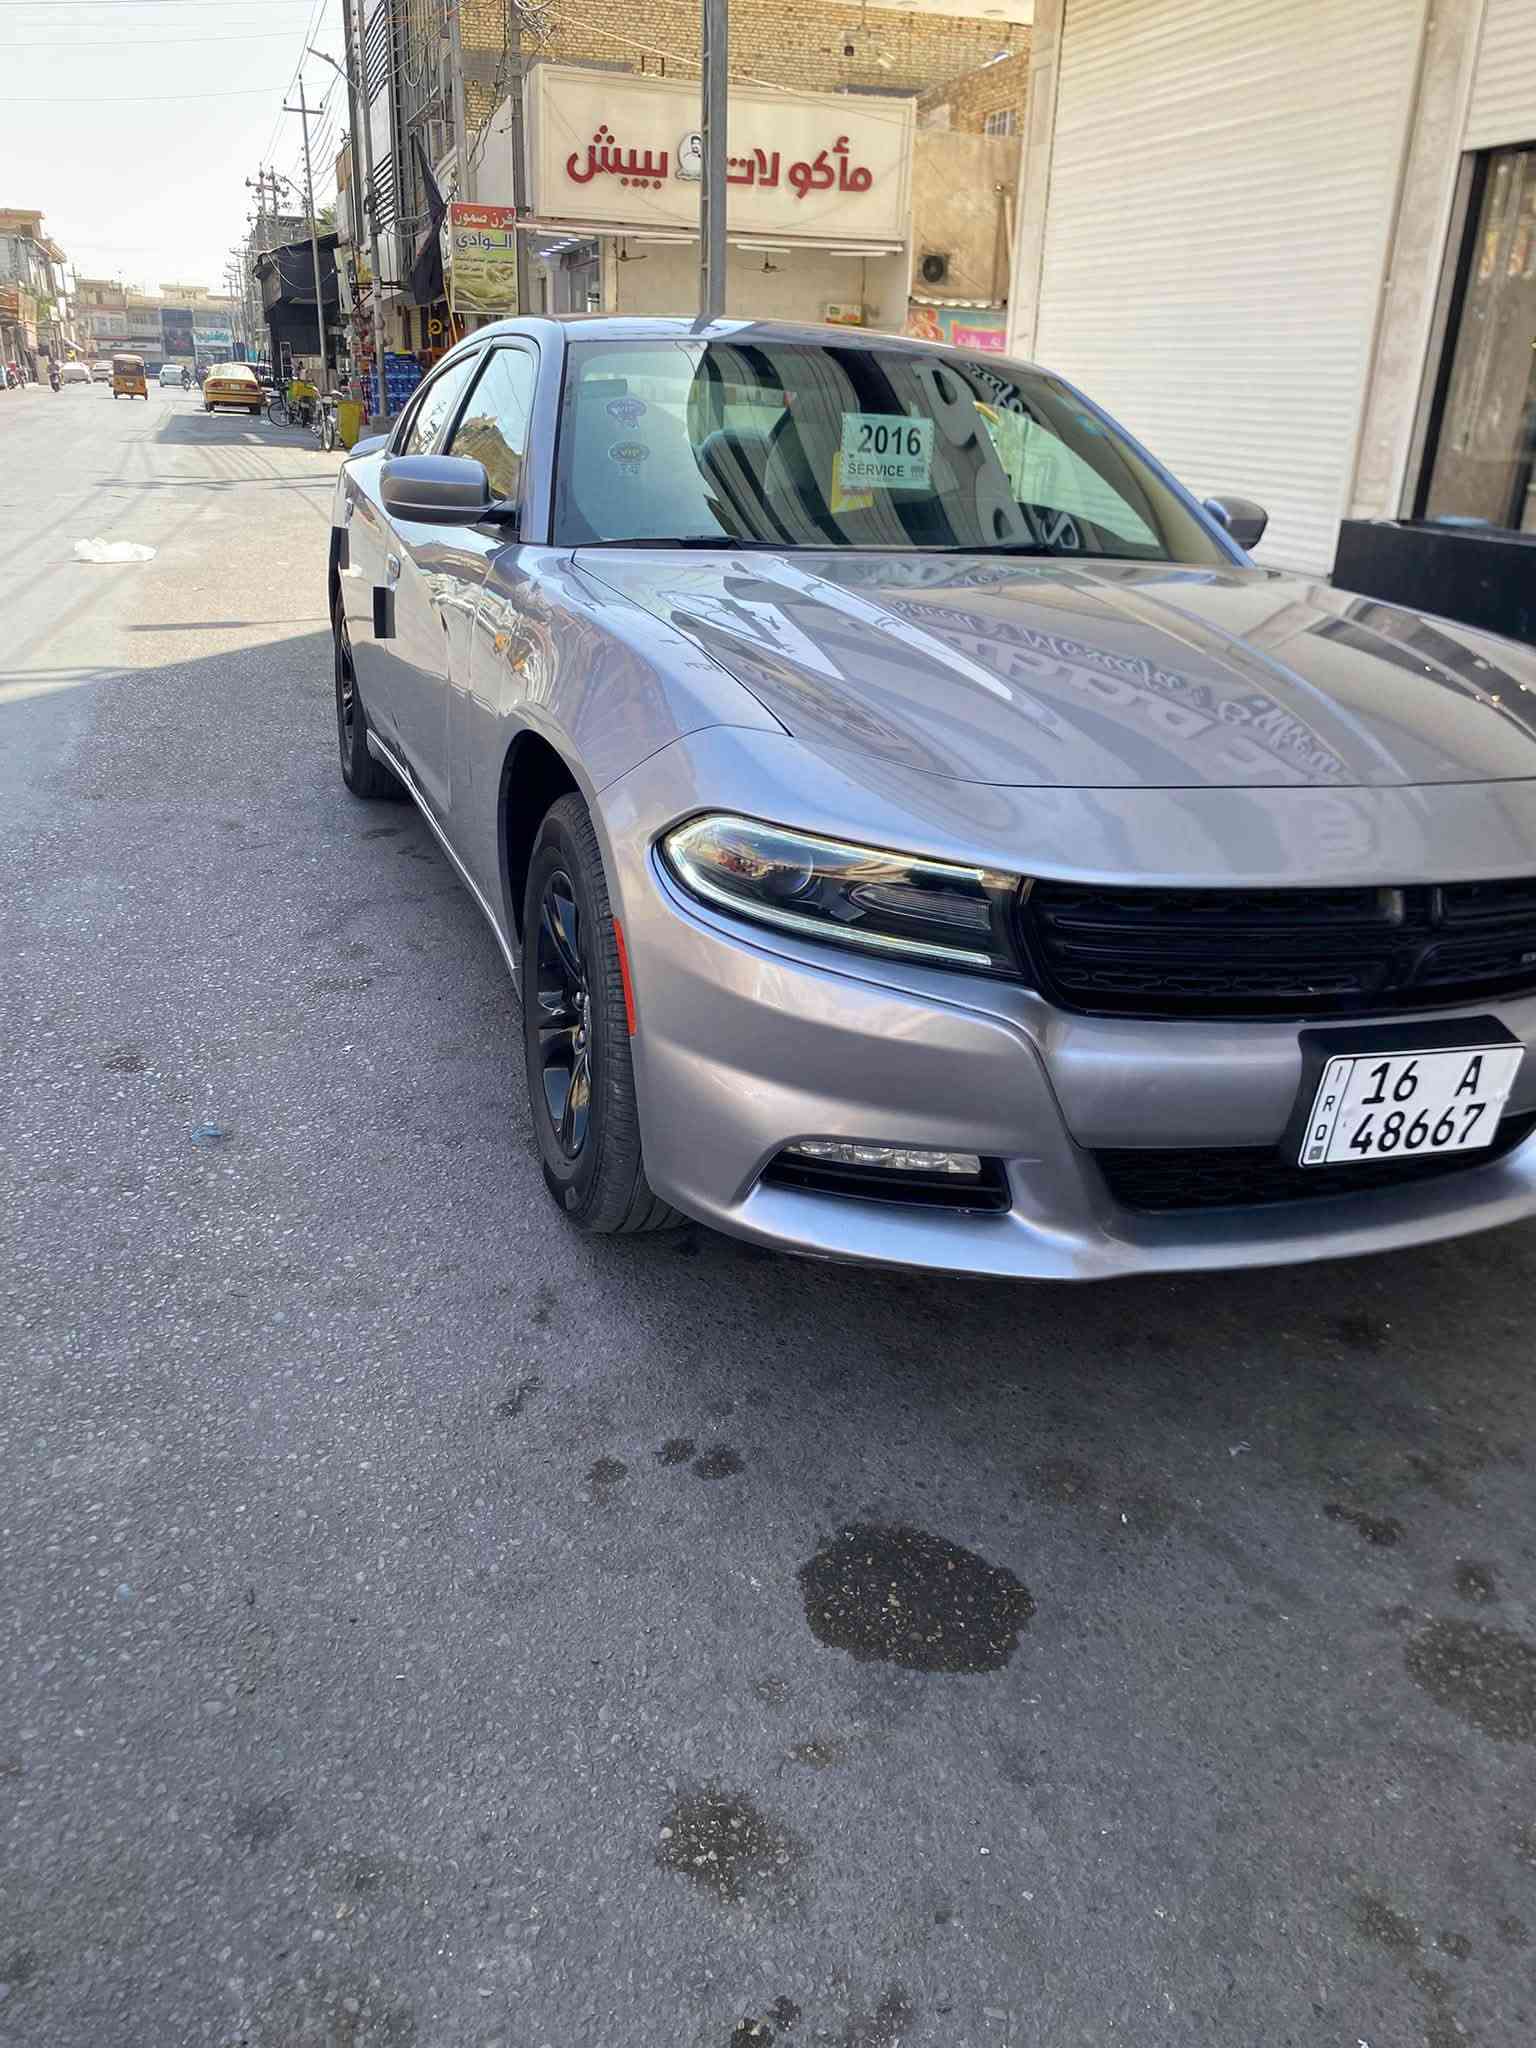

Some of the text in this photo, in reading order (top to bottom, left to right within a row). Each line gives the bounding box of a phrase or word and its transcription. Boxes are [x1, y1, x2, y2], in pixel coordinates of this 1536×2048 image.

[726, 135, 873, 199] مأكولات
[857, 424, 921, 456] 2016
[847, 462, 905, 477] SERVICE
[1360, 1055, 1484, 1105] 16 A
[1349, 1102, 1487, 1155] 48667
